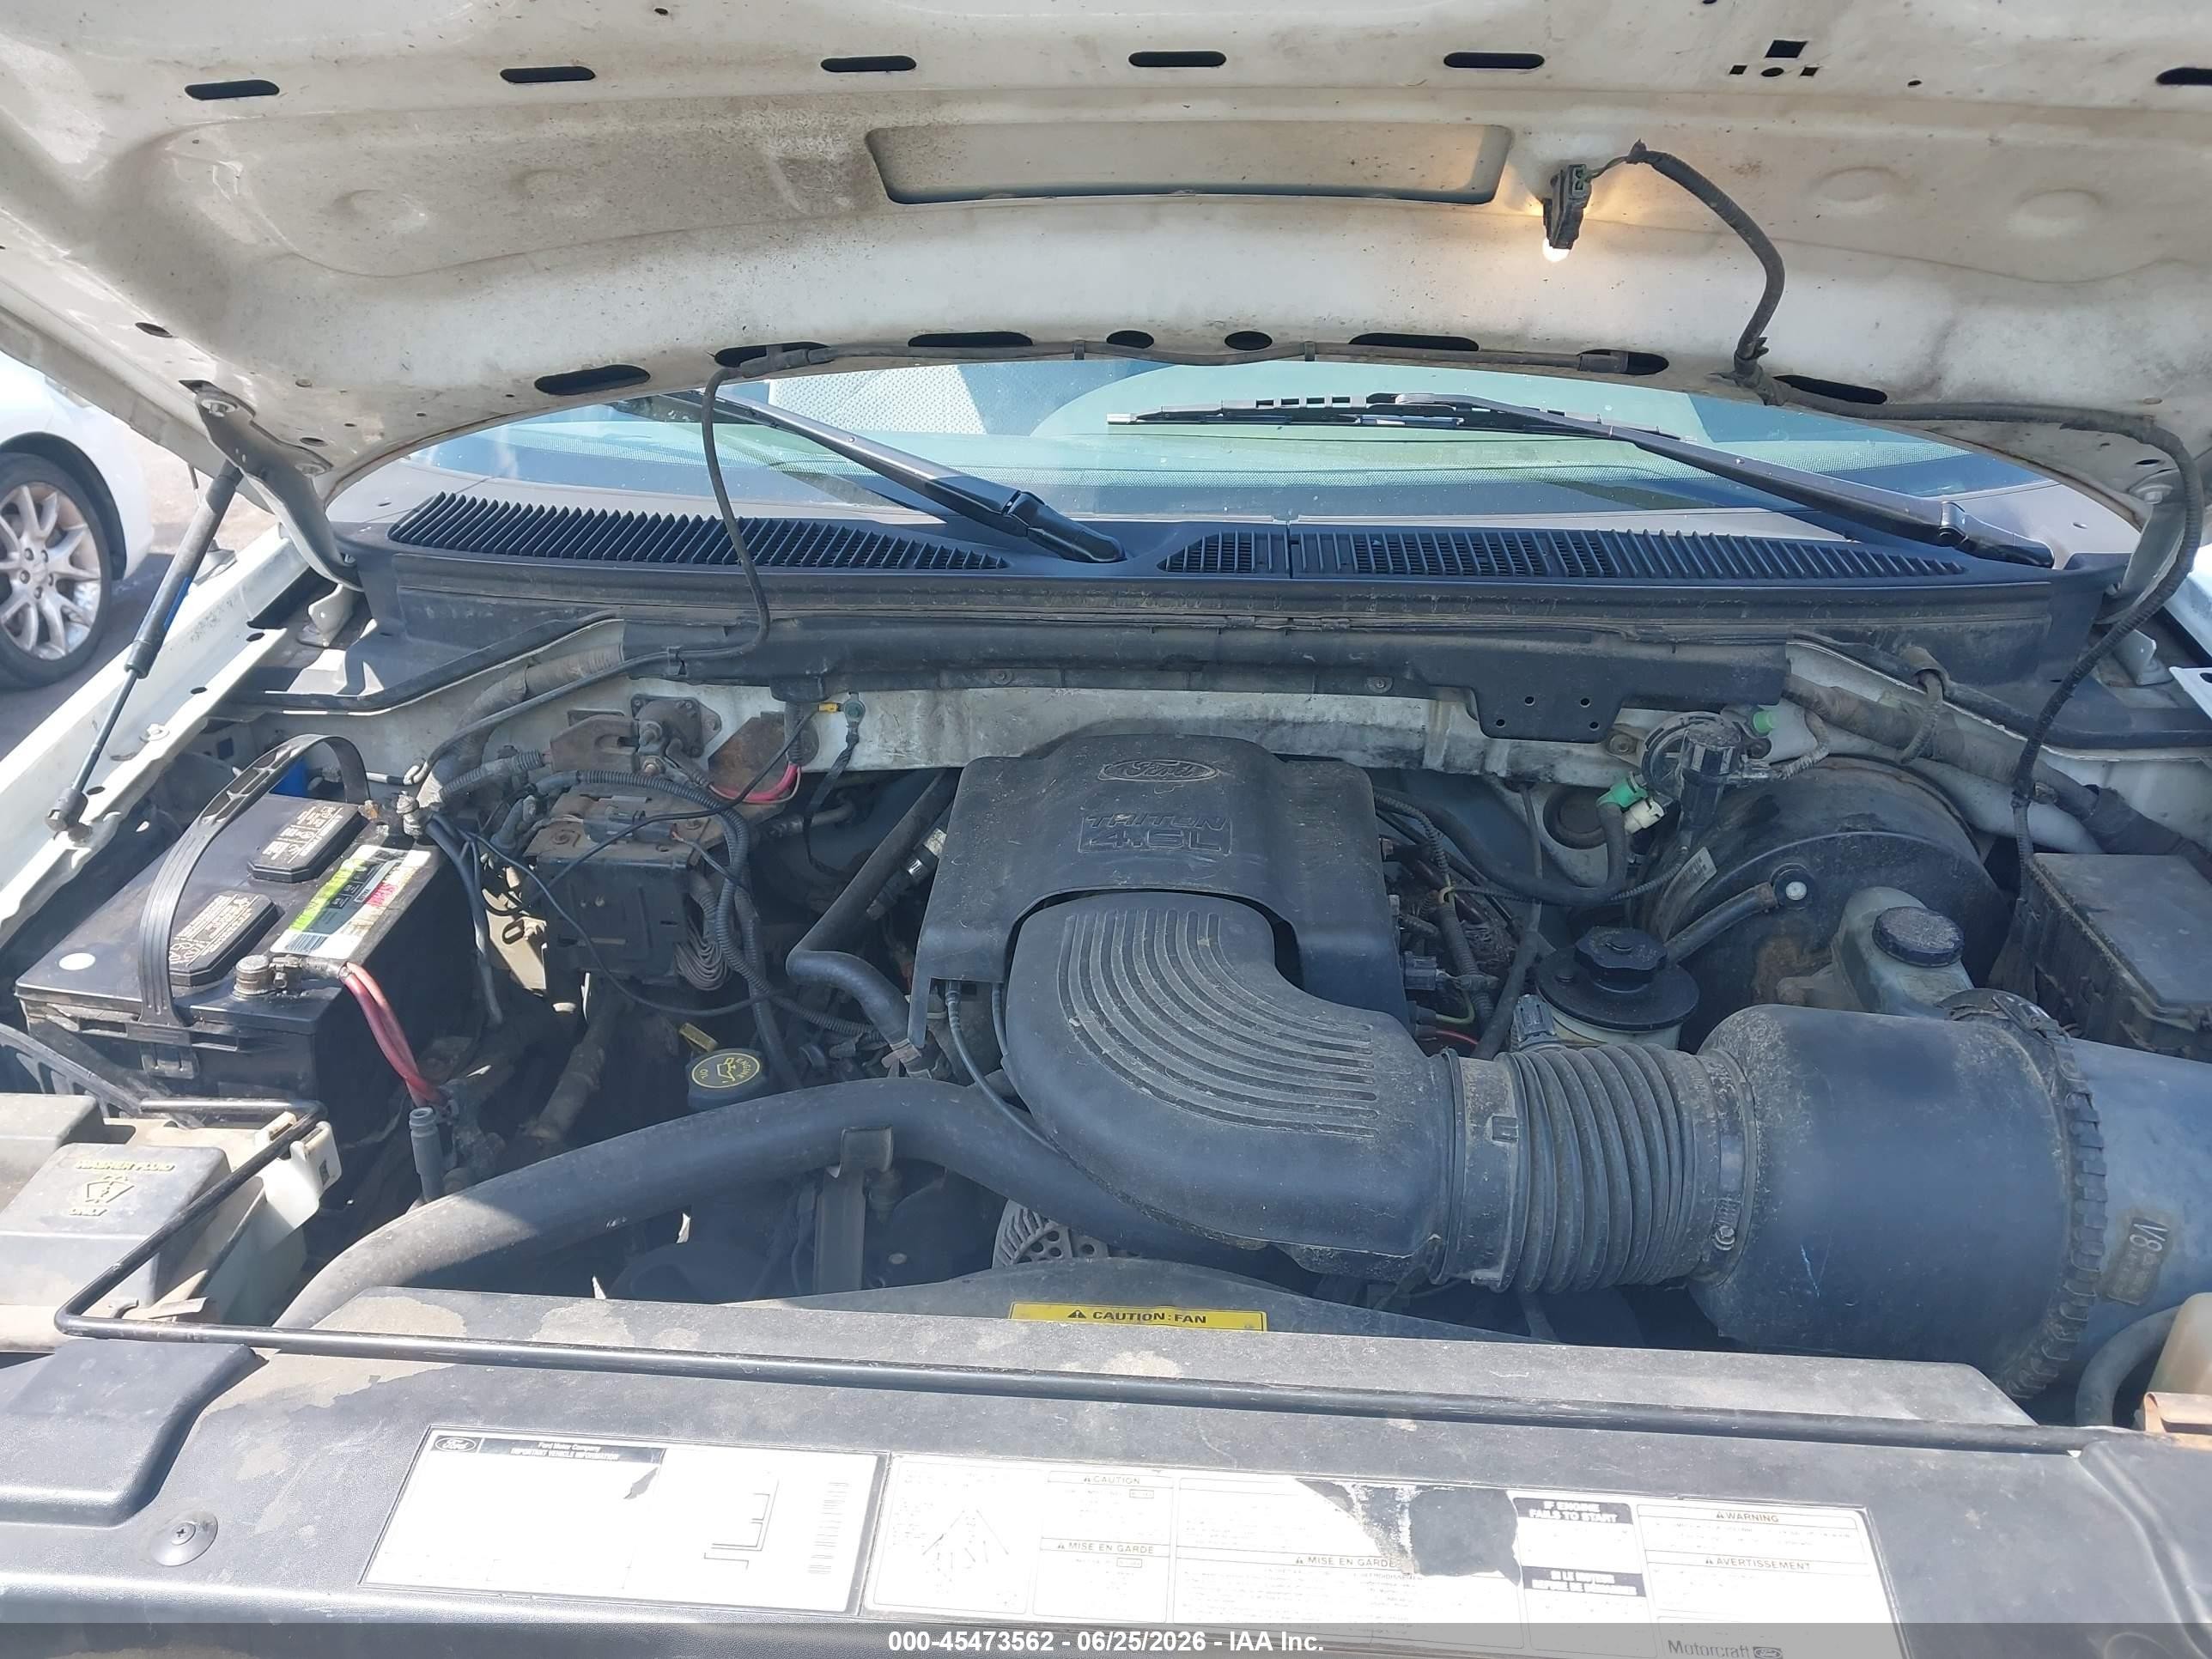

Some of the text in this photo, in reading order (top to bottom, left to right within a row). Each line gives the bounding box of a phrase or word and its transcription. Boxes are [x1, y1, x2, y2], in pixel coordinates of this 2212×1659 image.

[1085, 813, 1229, 831] TRITON
[1088, 829, 1223, 853] 4.6L
[700, 1069, 708, 1079] OIL
[76, 1160, 177, 1172] WASHER FLUID
[2130, 1223, 2169, 1251] V8
[1174, 1314, 1206, 1324] FAN
[552, 1443, 572, 1451] Motor
[571, 1443, 601, 1453] Company
[1093, 1475, 1140, 1485] CAUTION
[1528, 1509, 1618, 1523] FAILS TO START
[1726, 1511, 1780, 1522] WARNING
[1068, 1541, 1155, 1554] MISE EN GARDE
[1308, 1556, 1334, 1565] MISE
[1339, 1558, 1353, 1566] EN
[1717, 1558, 1811, 1570] AVERTISSEMENT
[1668, 1639, 1750, 1658] Motorcraft
